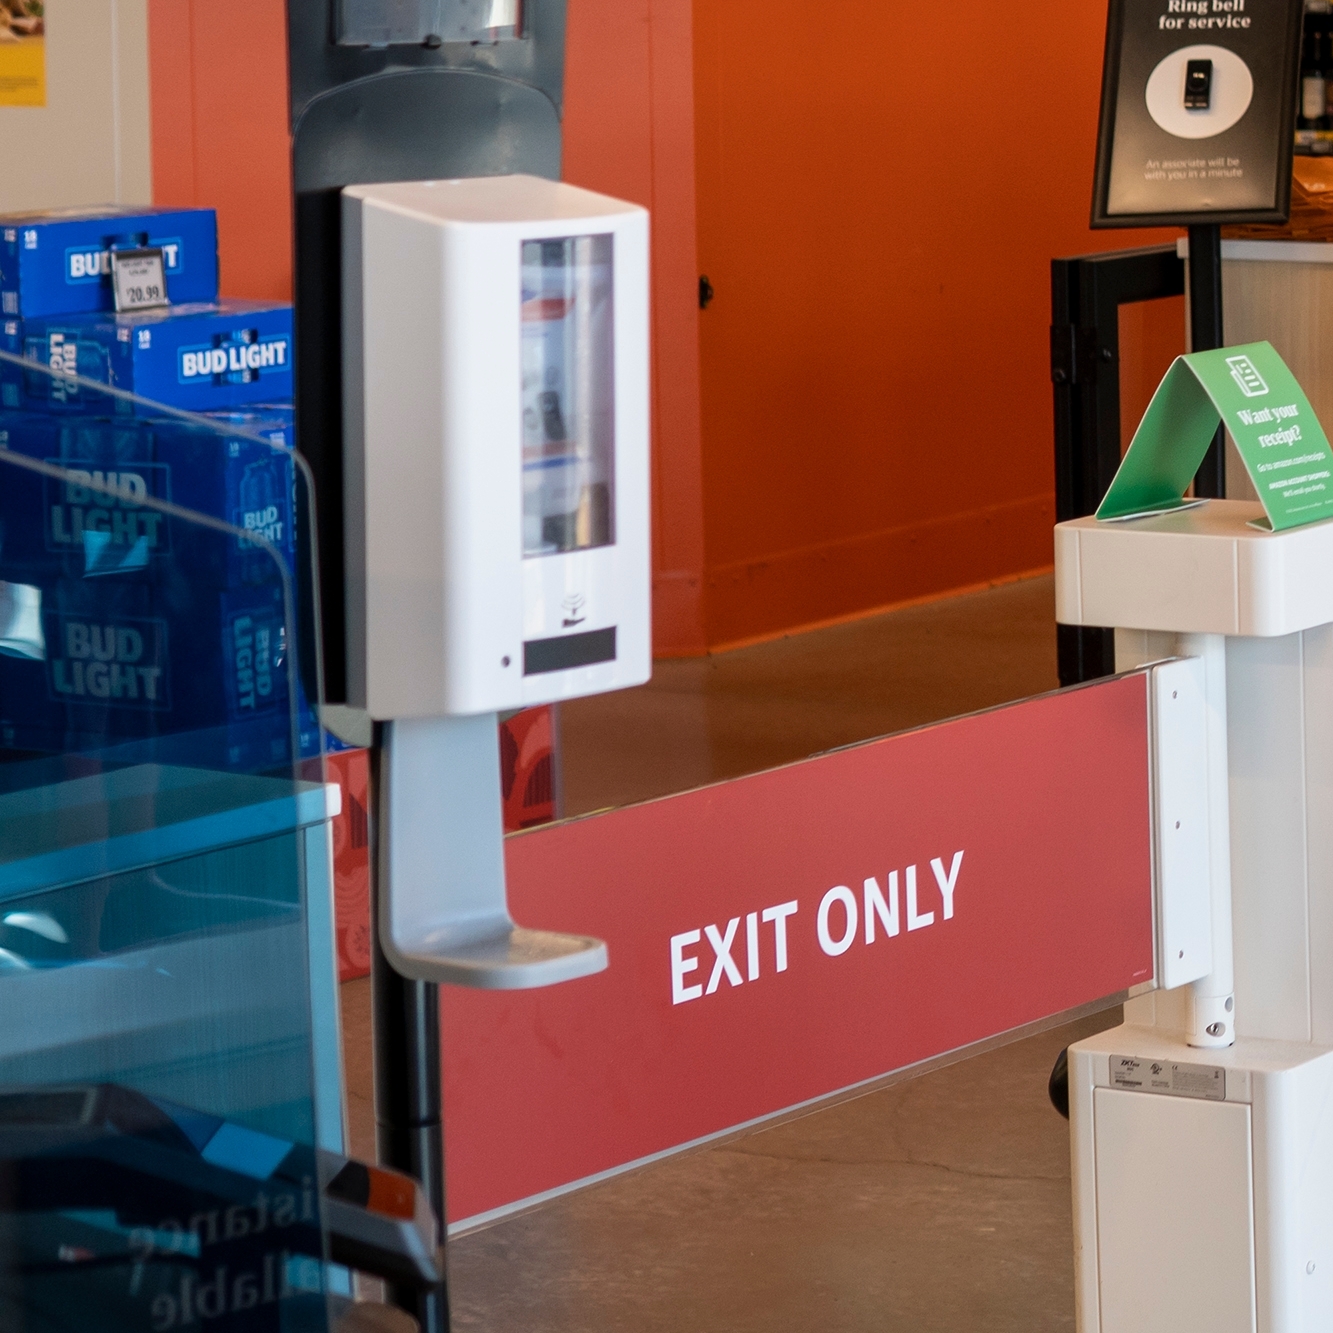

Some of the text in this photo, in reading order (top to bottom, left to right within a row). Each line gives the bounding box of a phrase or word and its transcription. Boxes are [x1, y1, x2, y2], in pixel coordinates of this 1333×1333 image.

[1158, 15, 1251, 30] for service
[182, 341, 287, 377] BUD LIGHT
[1237, 404, 1299, 426] Want your
[1258, 425, 1302, 448] receipt?
[66, 468, 147, 508] BUD
[66, 622, 143, 663] BUD
[53, 656, 162, 702] LIGHT
[669, 849, 965, 1006] EXIT ONLY
